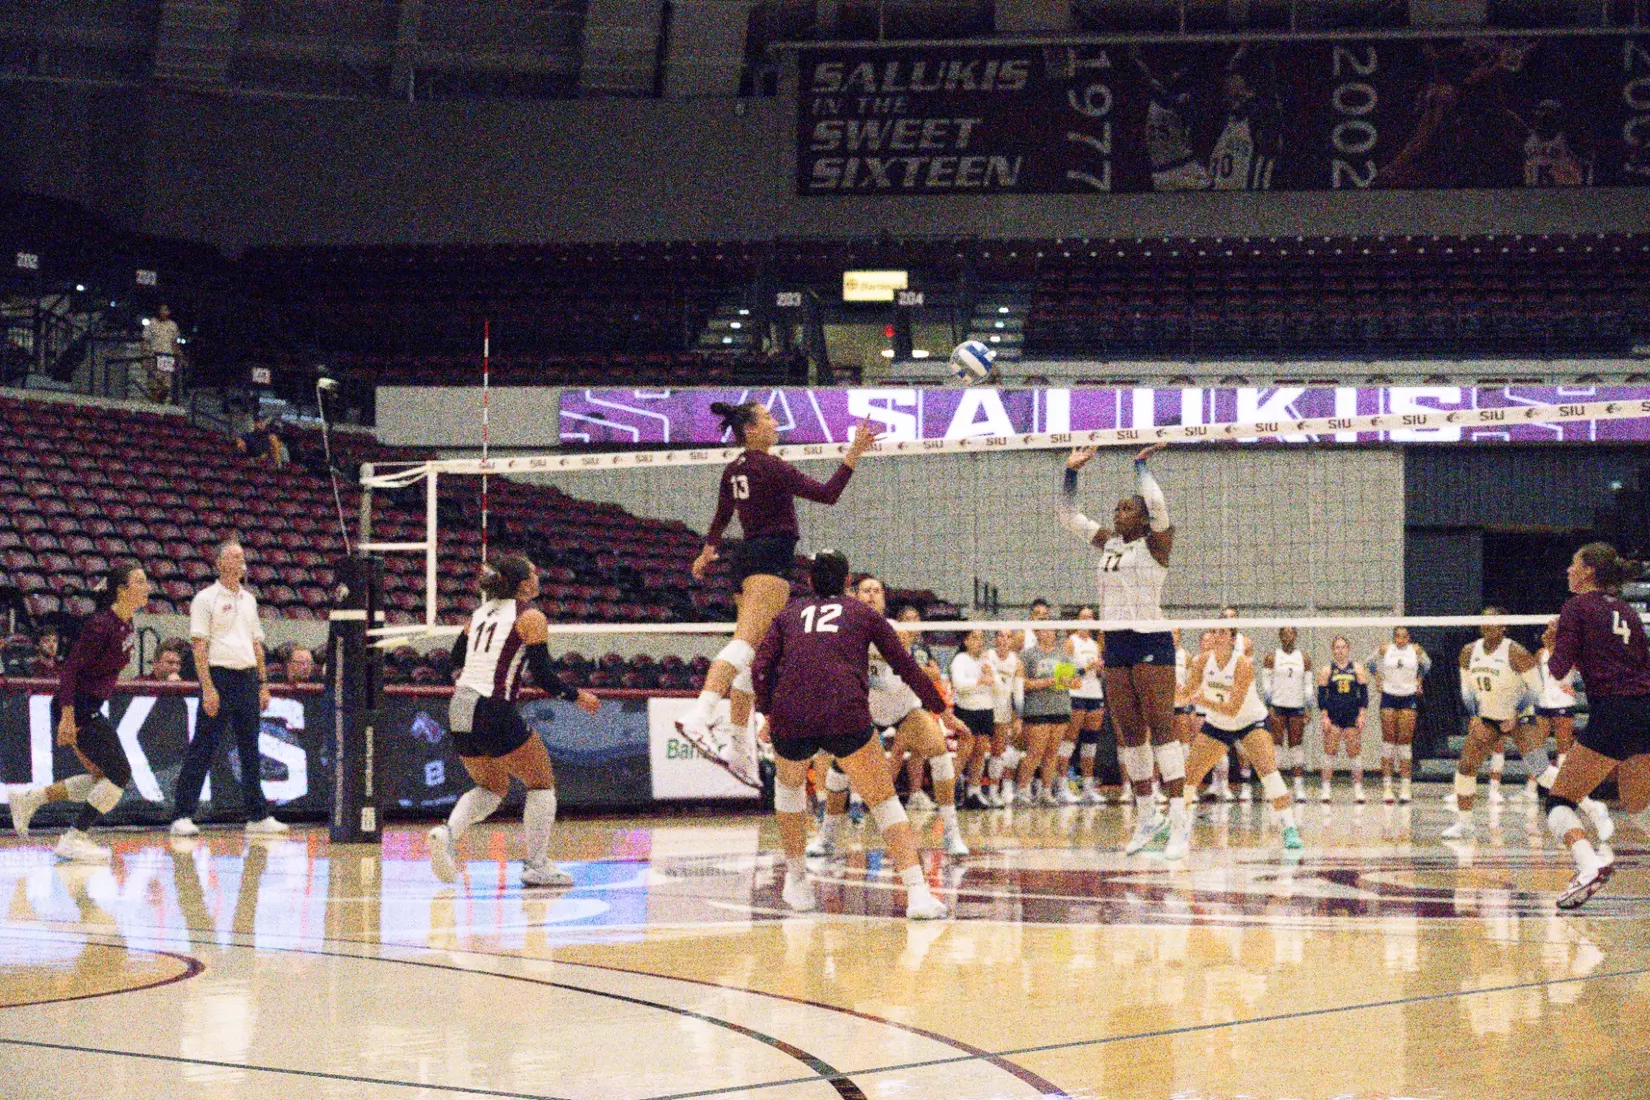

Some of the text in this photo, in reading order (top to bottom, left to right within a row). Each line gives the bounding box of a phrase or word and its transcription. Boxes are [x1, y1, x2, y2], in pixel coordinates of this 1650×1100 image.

[811, 60, 1029, 93] SALUKIS
[857, 97, 908, 114] THE
[1066, 48, 1112, 191] 1977
[1332, 46, 1377, 188] 2002
[810, 118, 981, 150] SWEET
[810, 156, 1023, 188] SIXTEEN
[847, 386, 1463, 443] SALUKIS
[923, 439, 944, 449] SIU
[986, 436, 1007, 446] SIU
[1050, 433, 1072, 443] SIU
[1117, 430, 1139, 440] SIU
[1184, 426, 1207, 437] SIU
[1255, 422, 1279, 433] SIU
[1328, 418, 1352, 429] SIU
[1402, 414, 1427, 425] SIU
[1479, 410, 1504, 421] SIU
[1559, 405, 1585, 417] SIU
[730, 474, 750, 499] 13
[800, 603, 843, 634] 12
[1612, 610, 1632, 645] 4
[474, 620, 498, 653] 11
